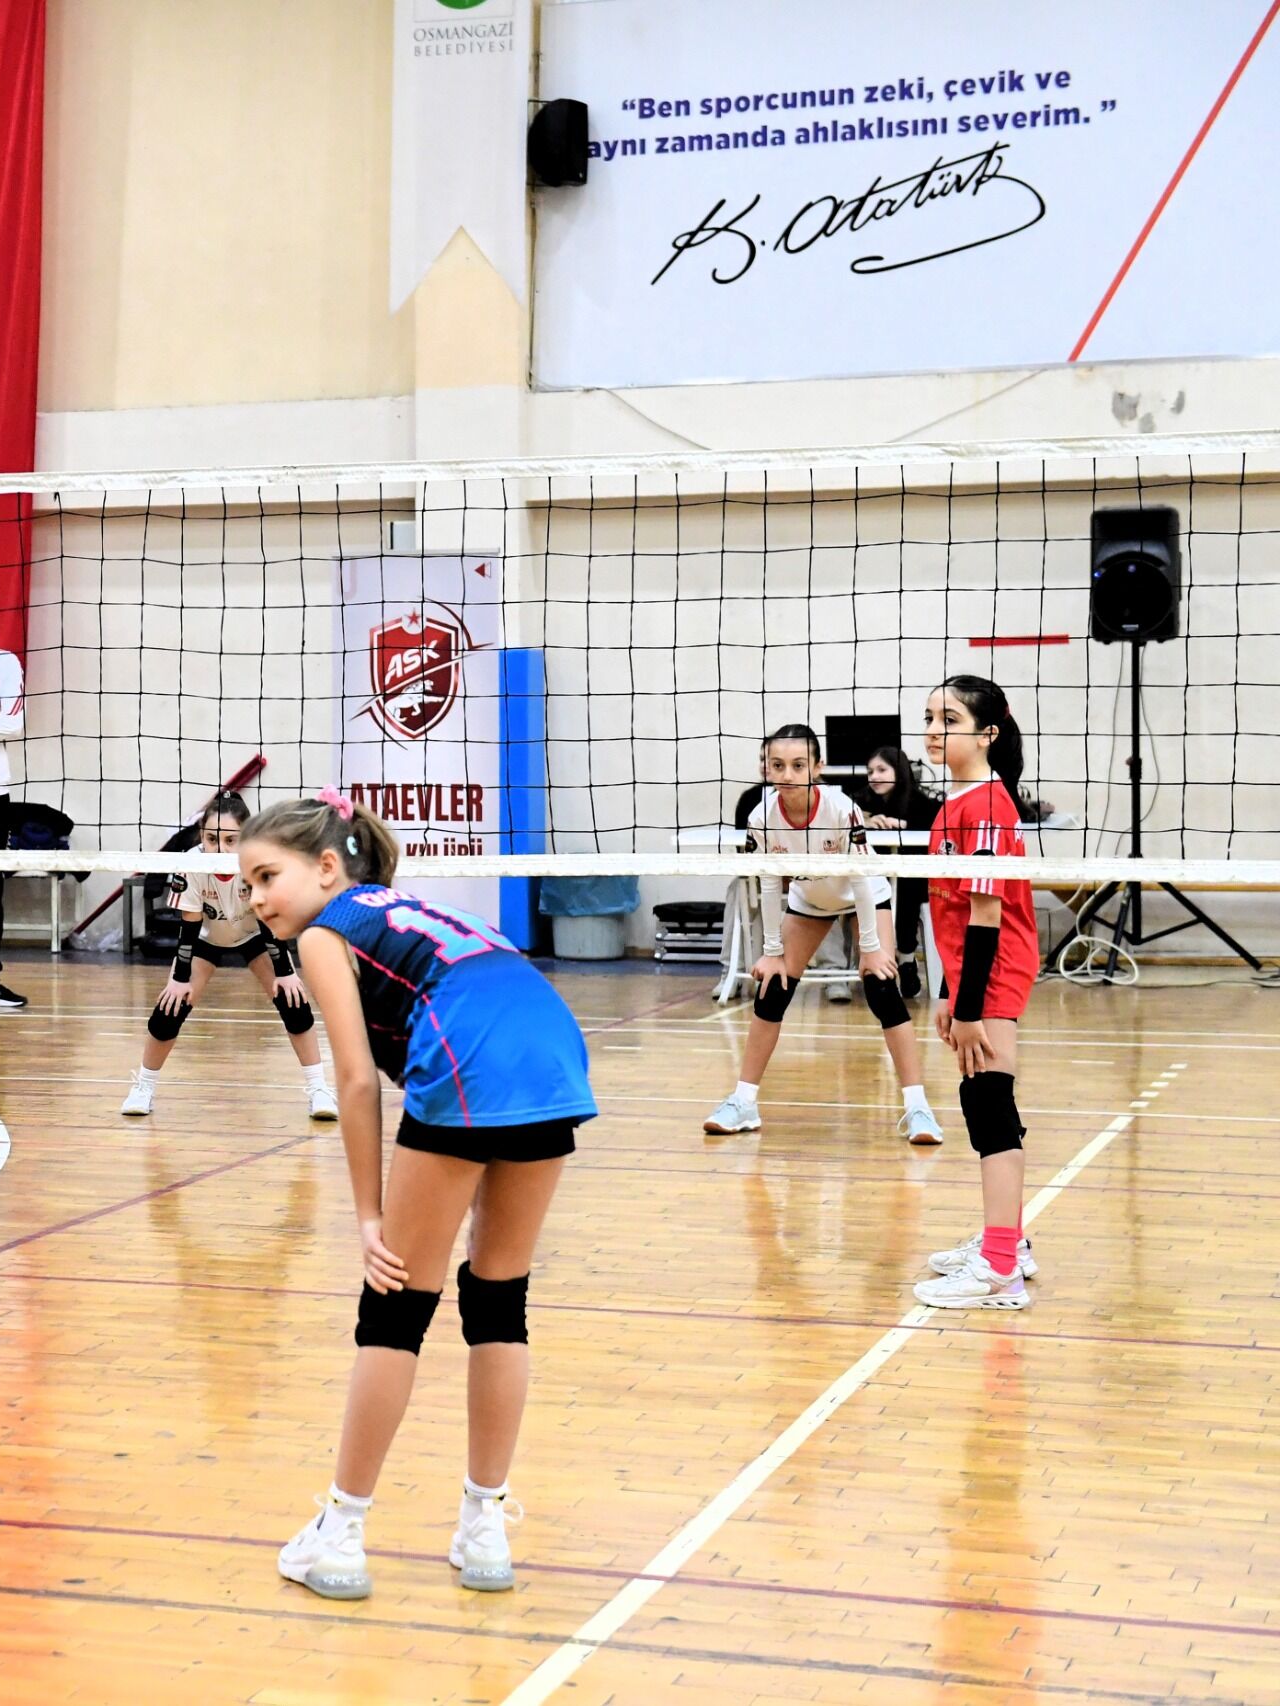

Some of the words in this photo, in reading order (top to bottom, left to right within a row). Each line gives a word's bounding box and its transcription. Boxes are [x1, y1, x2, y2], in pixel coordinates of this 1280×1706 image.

[413, 21, 513, 41] OSMANGAZİ
[414, 38, 513, 57] BELEDİYESİ
[621, 97, 691, 119] “Ben
[699, 86, 855, 119] sporcunun
[863, 77, 934, 103] zeki,
[943, 70, 1025, 101] çevik
[1035, 70, 1072, 90] ve
[587, 137, 646, 161] aynı
[654, 125, 786, 154] zamanda
[794, 116, 948, 143] ahlaklısını
[957, 104, 1091, 133] severim.
[384, 640, 441, 685] ASK
[350, 783, 483, 822] ATAEVLER
